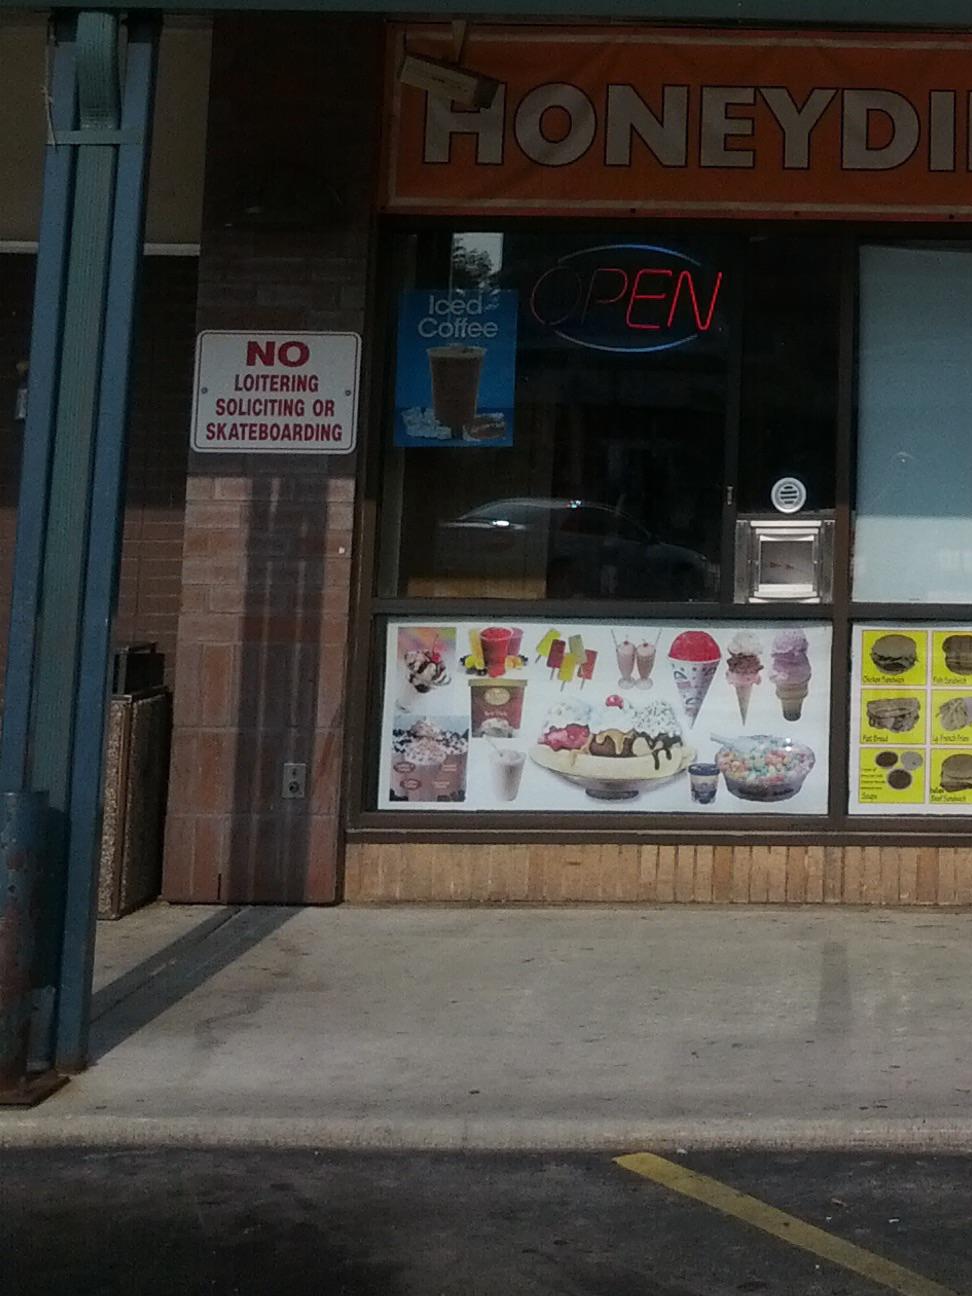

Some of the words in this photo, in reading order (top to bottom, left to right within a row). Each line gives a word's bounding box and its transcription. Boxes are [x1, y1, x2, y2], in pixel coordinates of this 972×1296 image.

[428, 295, 482, 316] Iced
[531, 267, 723, 331] OPEN
[417, 317, 499, 339] Coffee
[246, 340, 310, 367] NO
[234, 374, 319, 392] LOITERING
[215, 398, 305, 417] SOLICITING
[312, 399, 335, 417] OR
[206, 422, 342, 441] SKATEBOARDING
